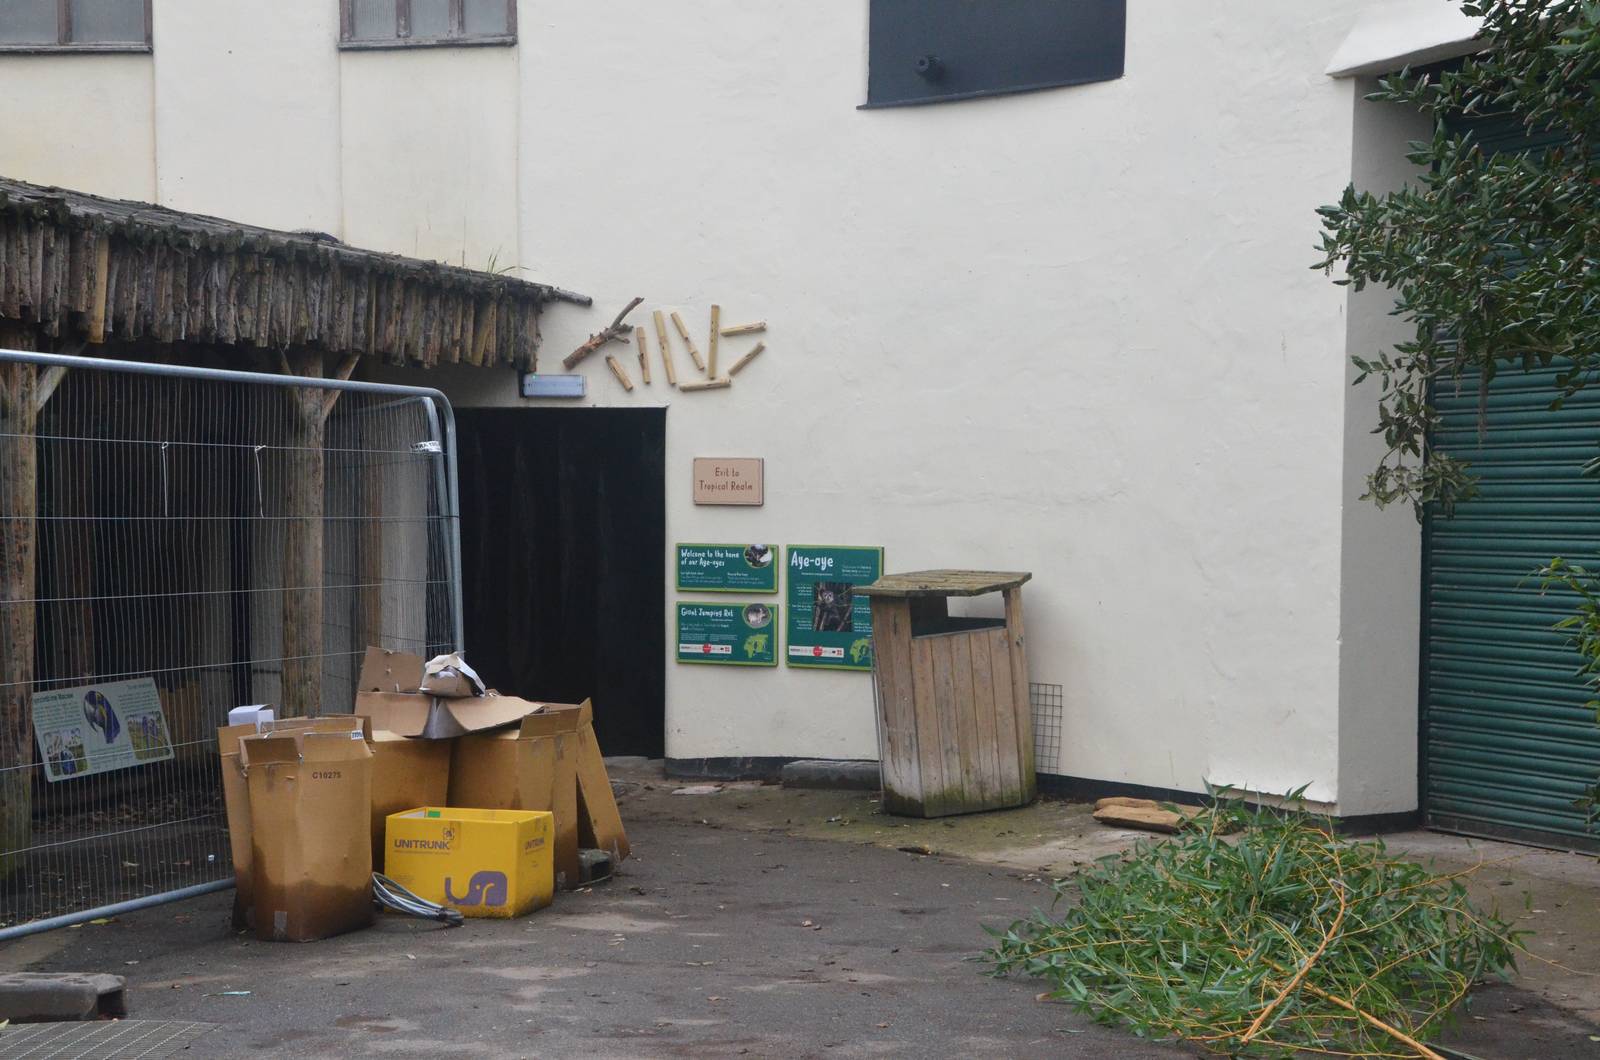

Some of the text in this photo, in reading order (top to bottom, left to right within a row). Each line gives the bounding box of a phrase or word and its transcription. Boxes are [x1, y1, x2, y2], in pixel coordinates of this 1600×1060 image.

[715, 467, 740, 477] Exit to
[700, 480, 753, 492] Tropical Realm
[681, 549, 740, 558] Welcome to the home
[791, 550, 834, 571] Aye-aye
[681, 607, 734, 618] Giant Jumping Rat
[312, 771, 341, 779] C10275
[394, 838, 450, 850] UNITRUNK
